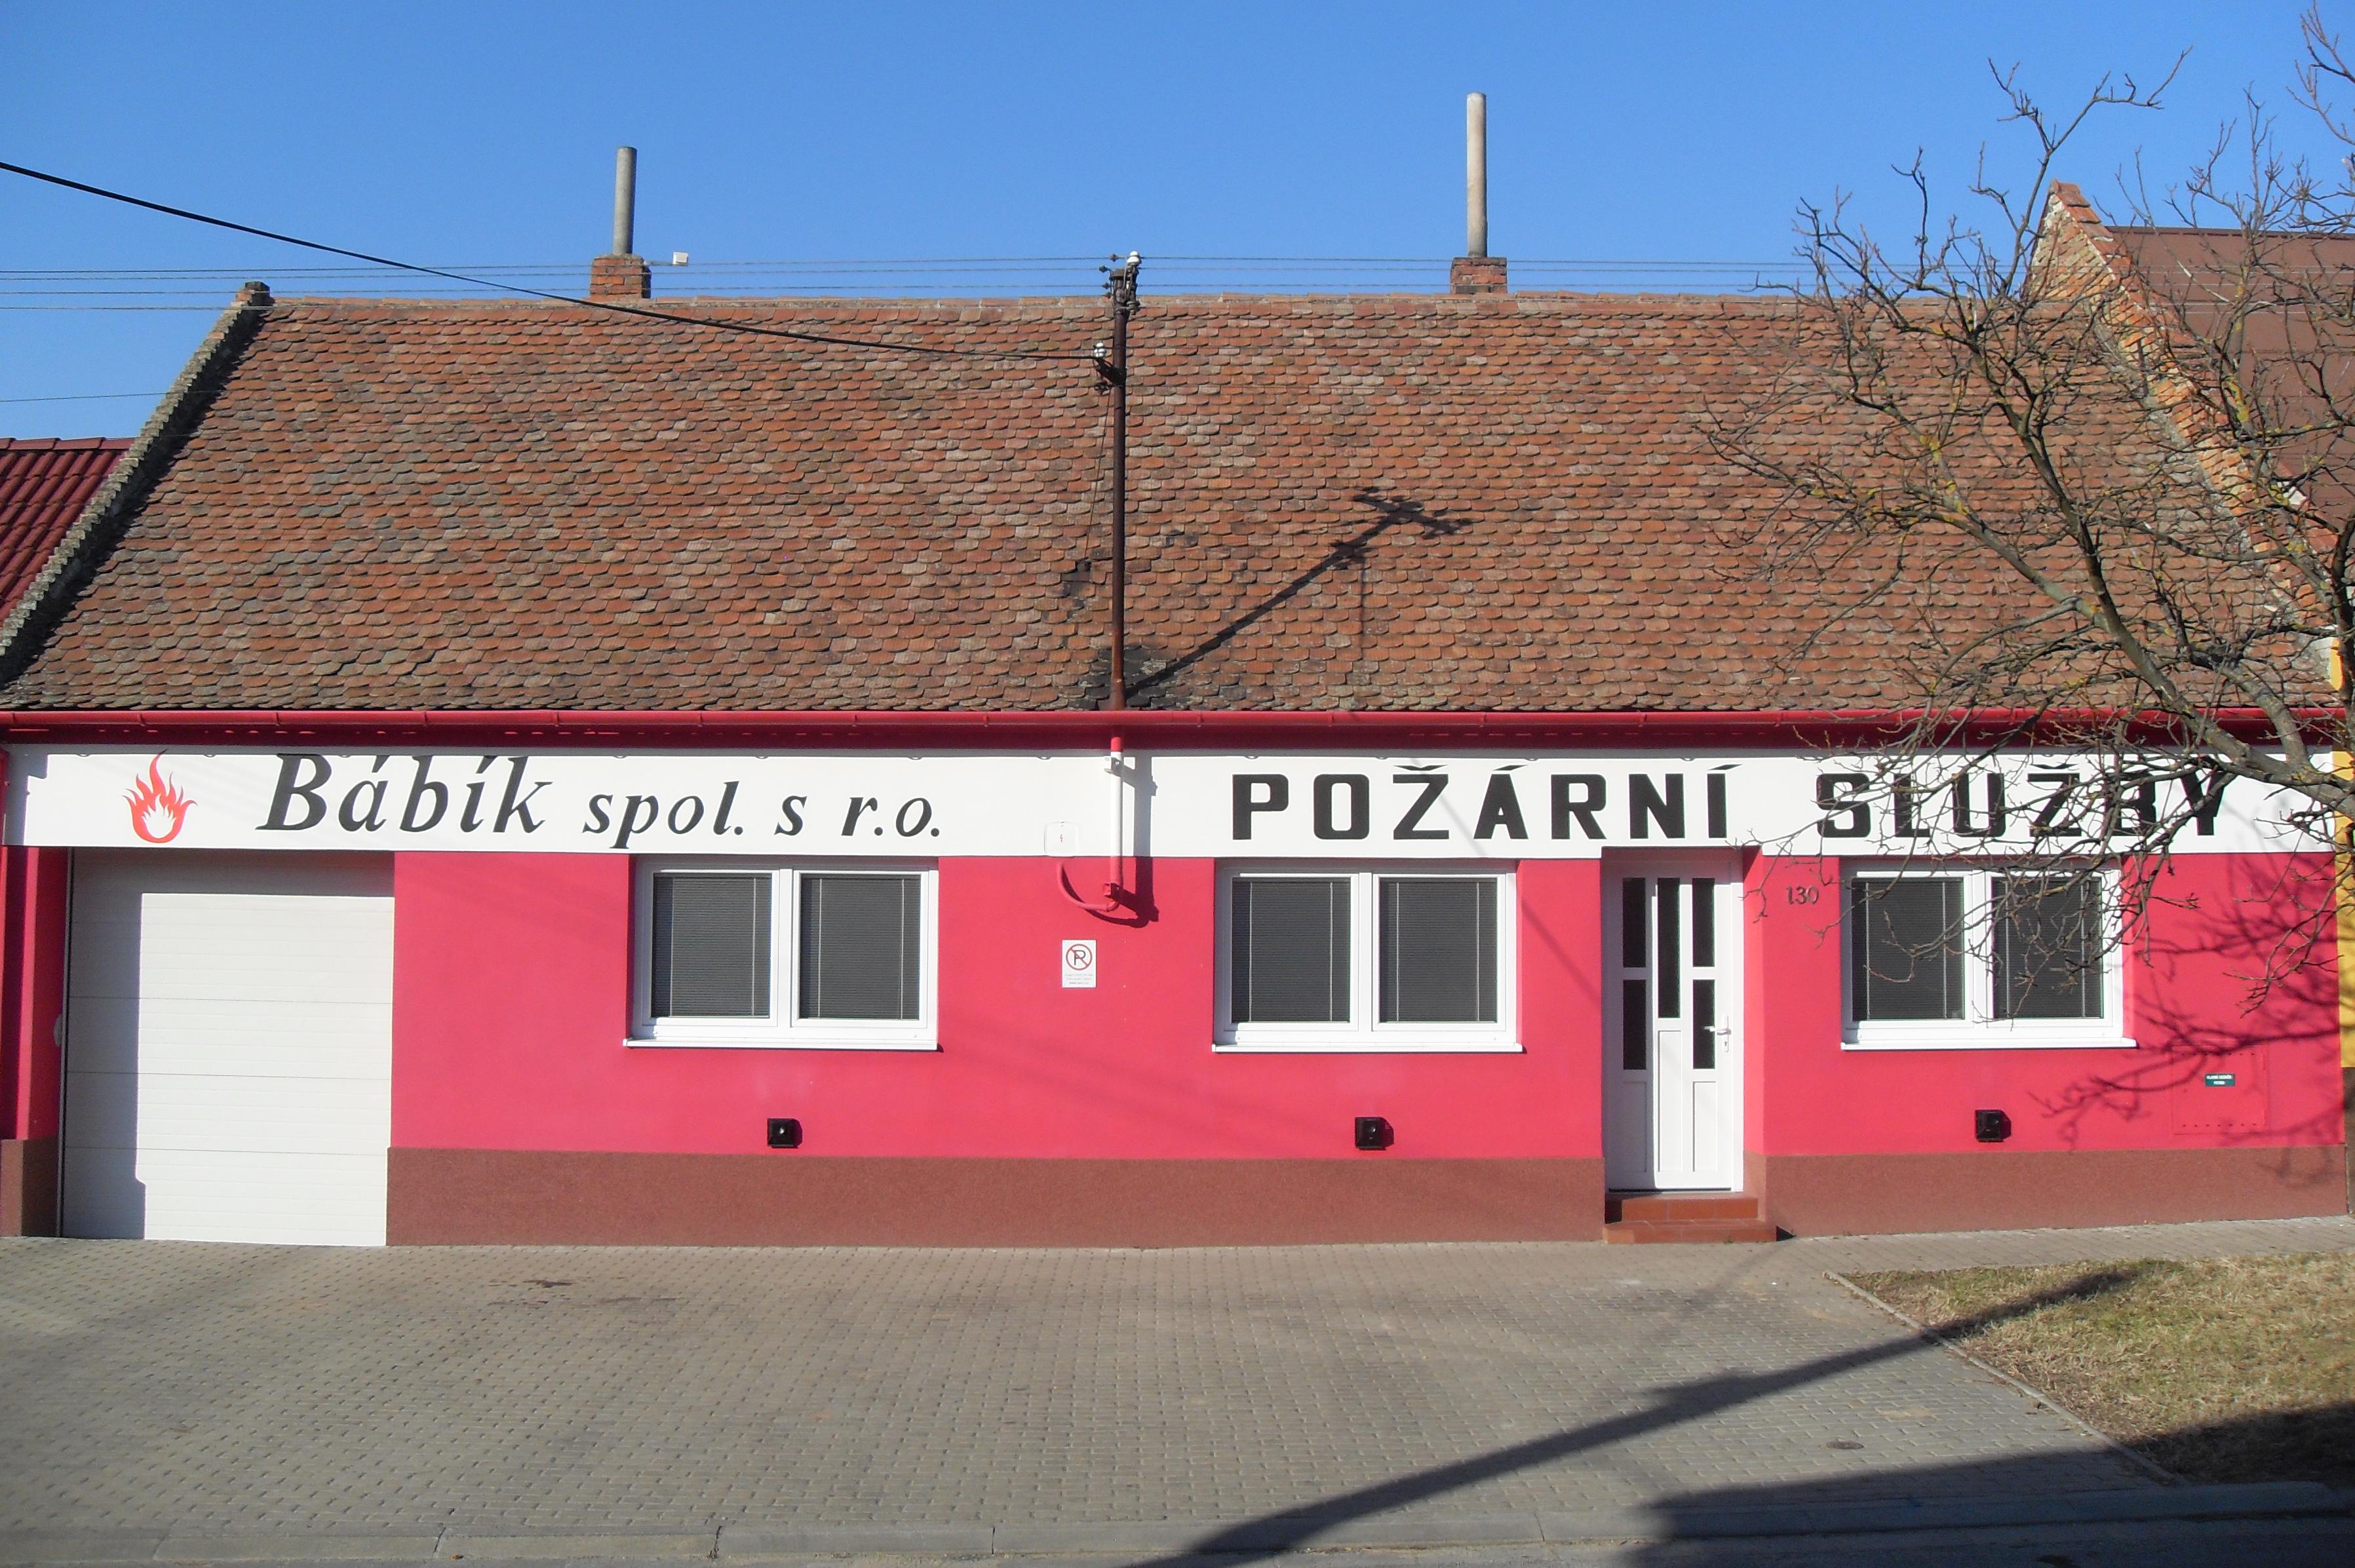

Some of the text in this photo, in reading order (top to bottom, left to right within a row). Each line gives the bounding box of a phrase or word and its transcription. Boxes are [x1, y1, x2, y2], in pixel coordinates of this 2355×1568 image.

[255, 752, 940, 849] Bábík spol. s r.o.
[1232, 764, 2230, 840] POŽÁRNÍ SLUŽBY
[1786, 886, 1820, 905] 130
